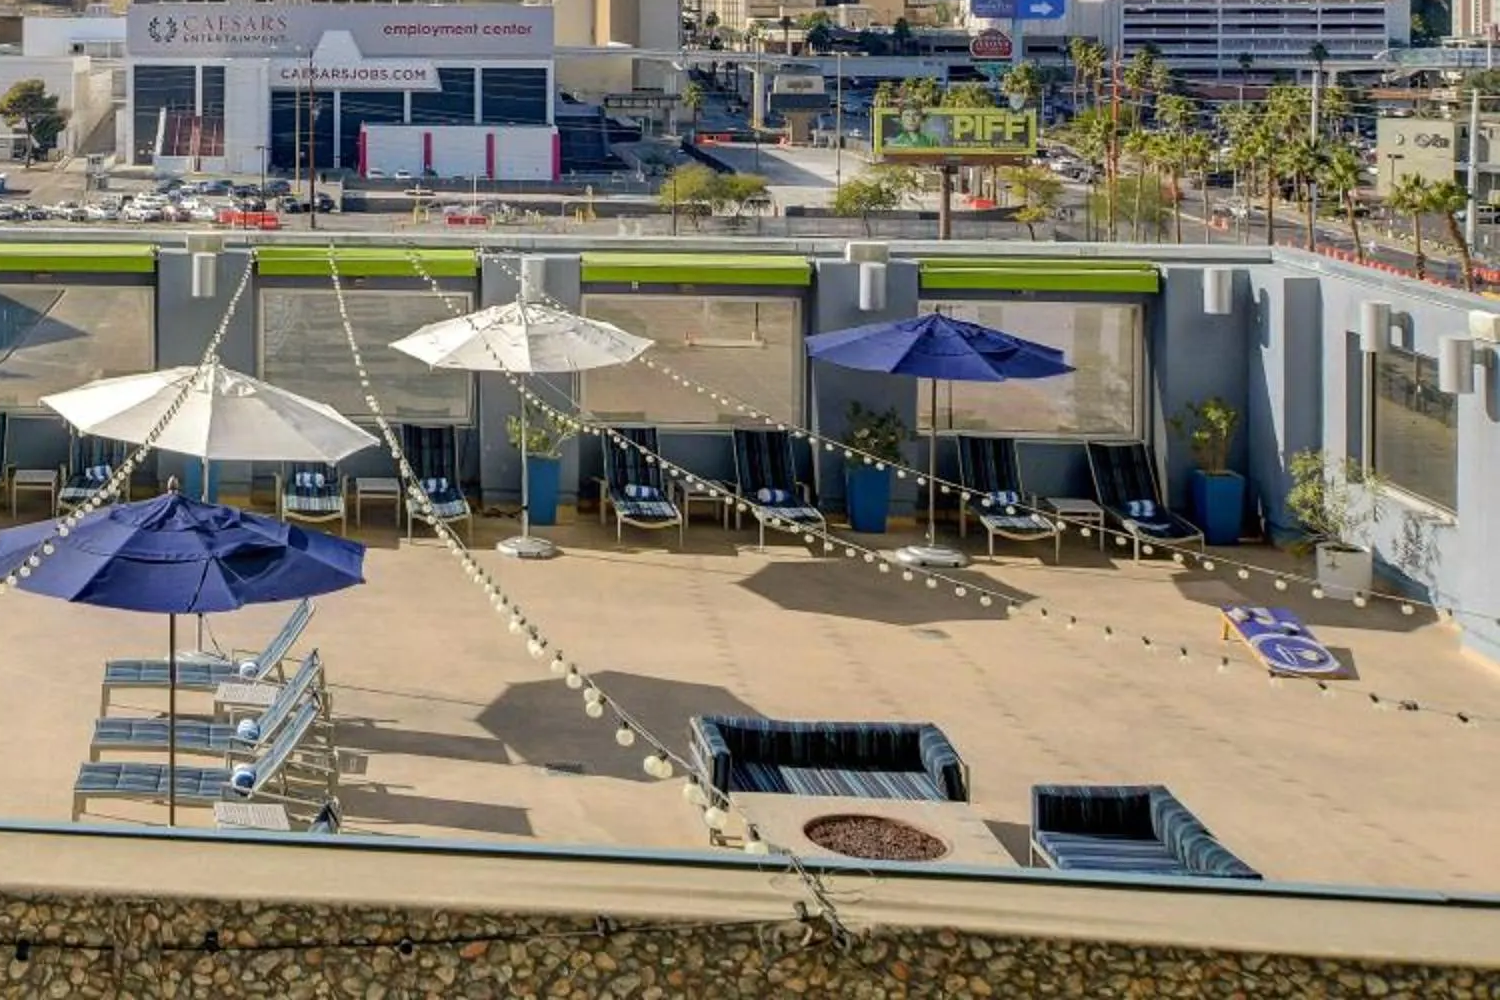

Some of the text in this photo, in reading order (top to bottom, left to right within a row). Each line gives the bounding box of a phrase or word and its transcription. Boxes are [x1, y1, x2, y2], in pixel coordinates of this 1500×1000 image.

[183, 15, 288, 32] CAESARS
[383, 23, 533, 37] employment center
[280, 67, 427, 81] CAESARSJOBS.COM
[953, 115, 1026, 141] PIFF
